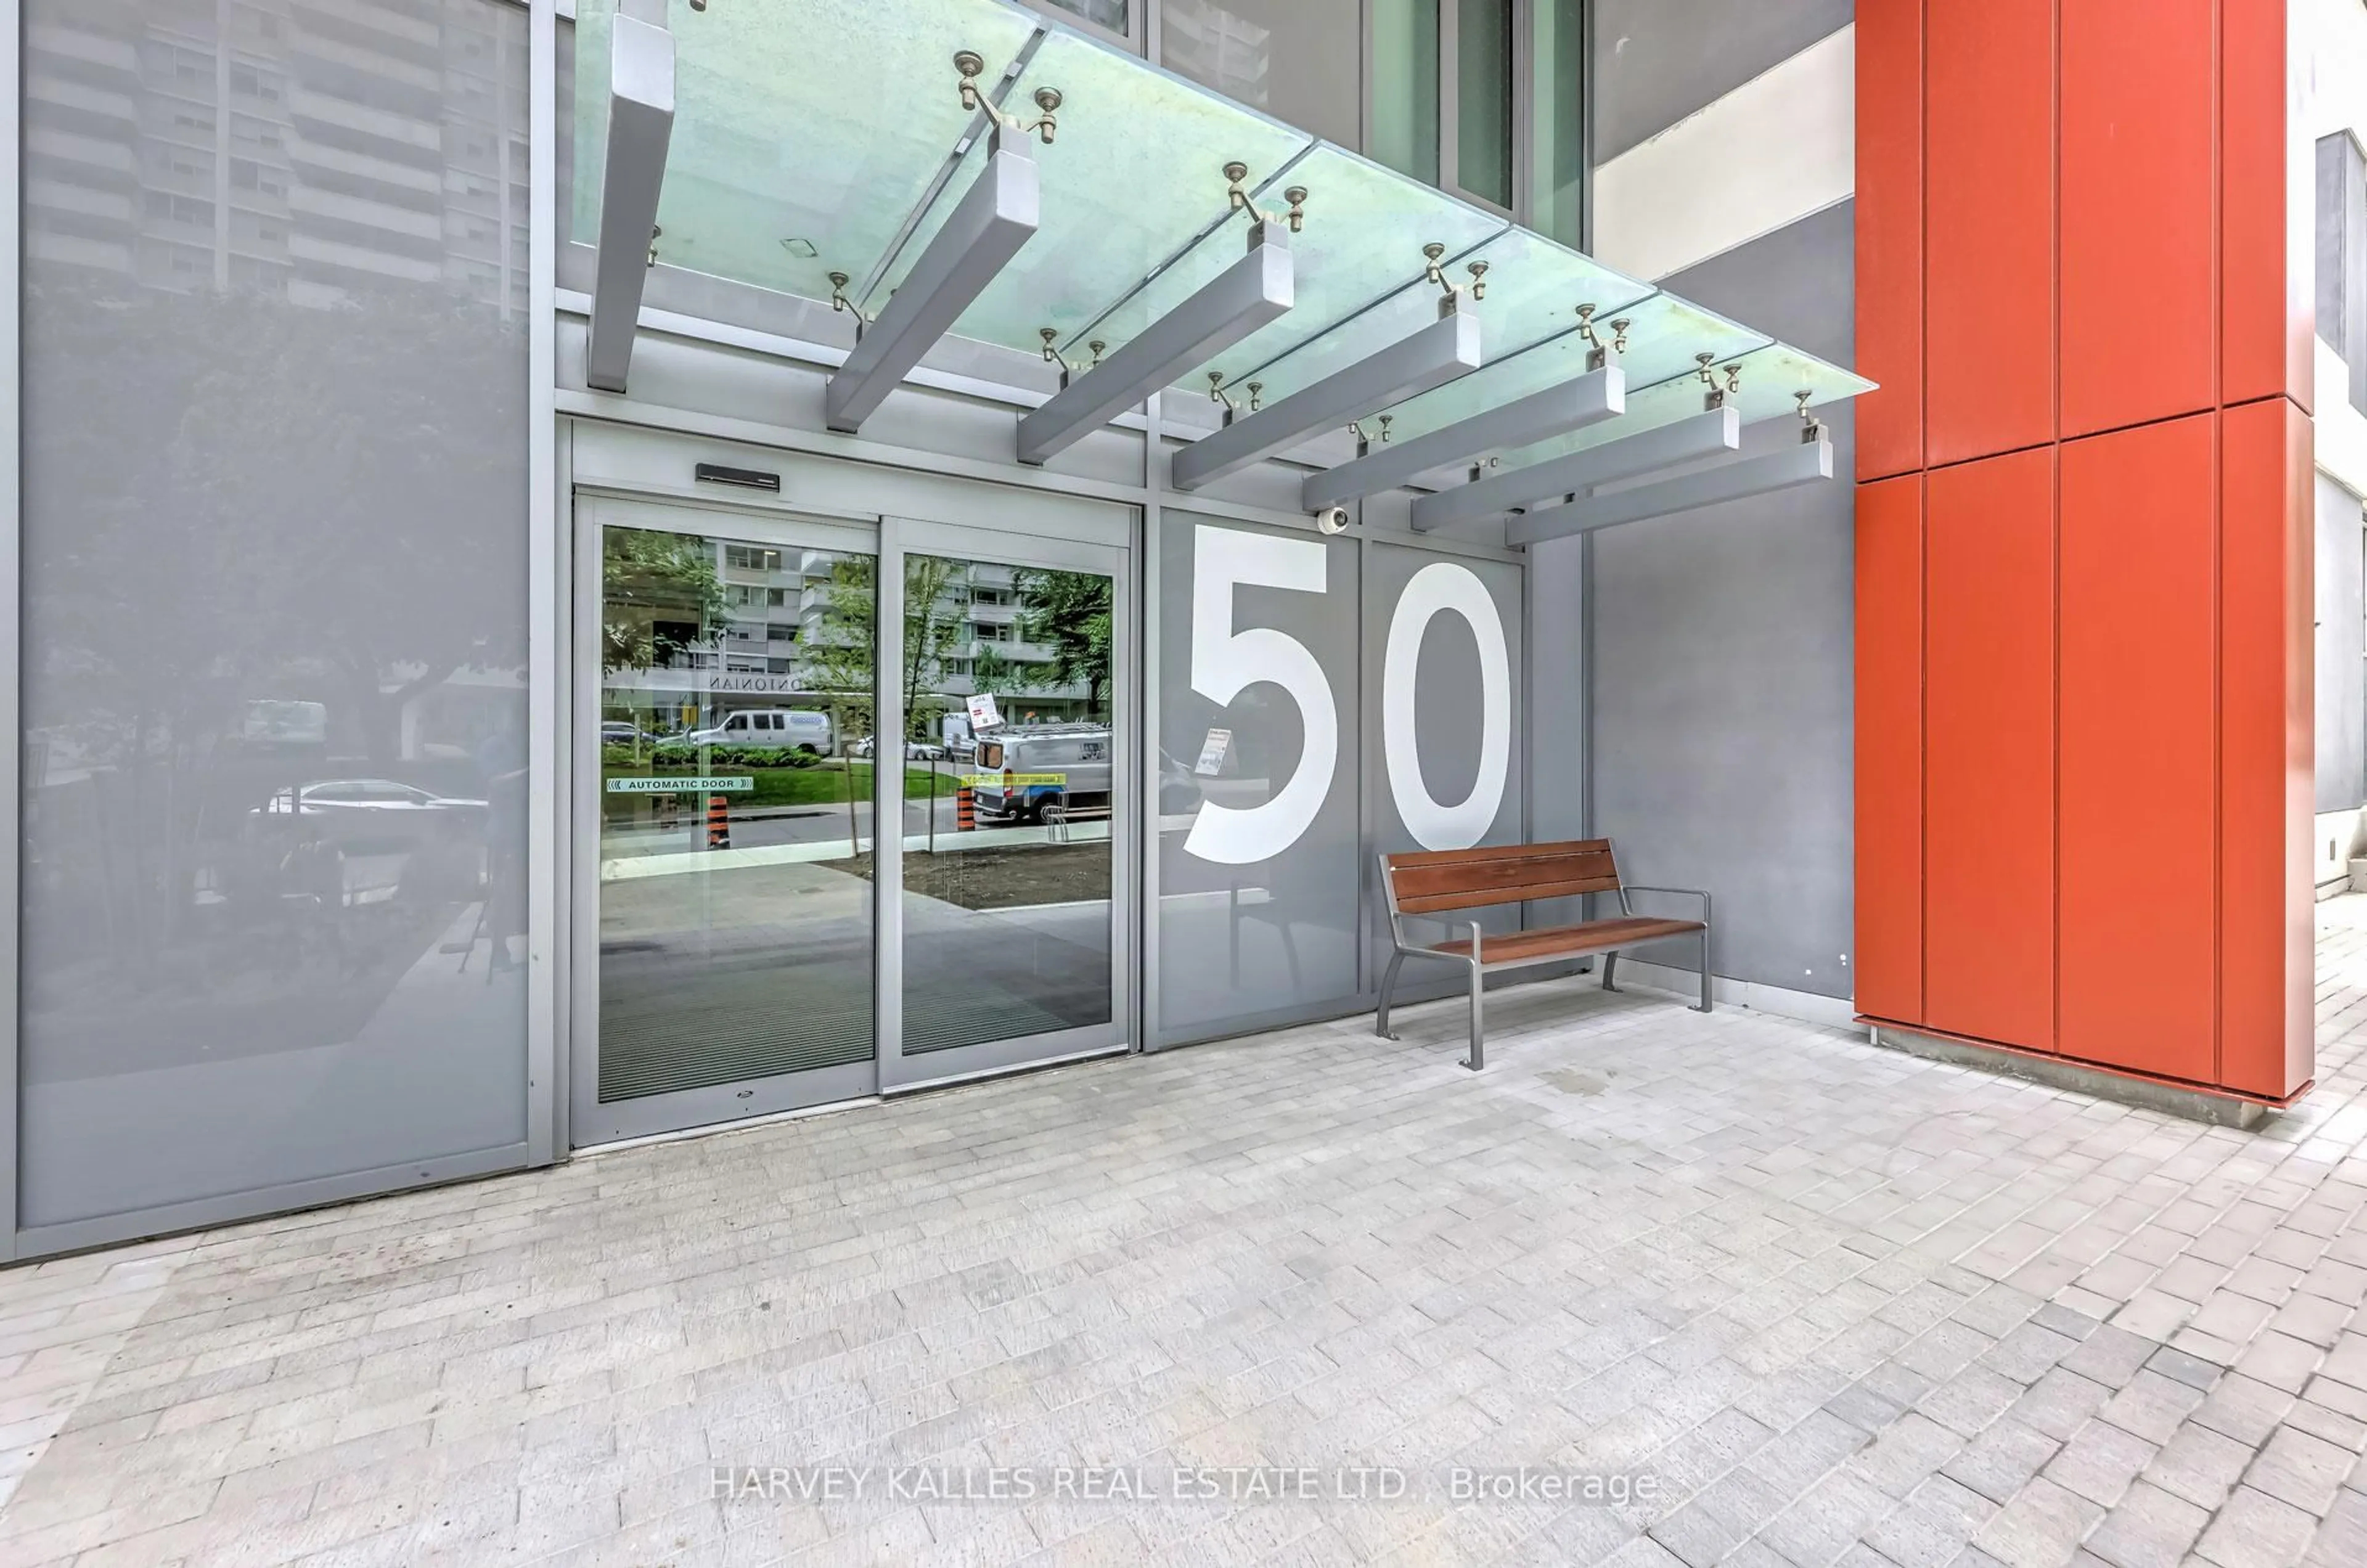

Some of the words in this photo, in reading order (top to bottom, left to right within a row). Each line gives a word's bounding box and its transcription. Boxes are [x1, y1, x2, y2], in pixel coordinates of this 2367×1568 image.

[1183, 524, 1511, 864] 50
[629, 780, 697, 789] AUTOMATIC
[702, 780, 734, 788] DOOR
